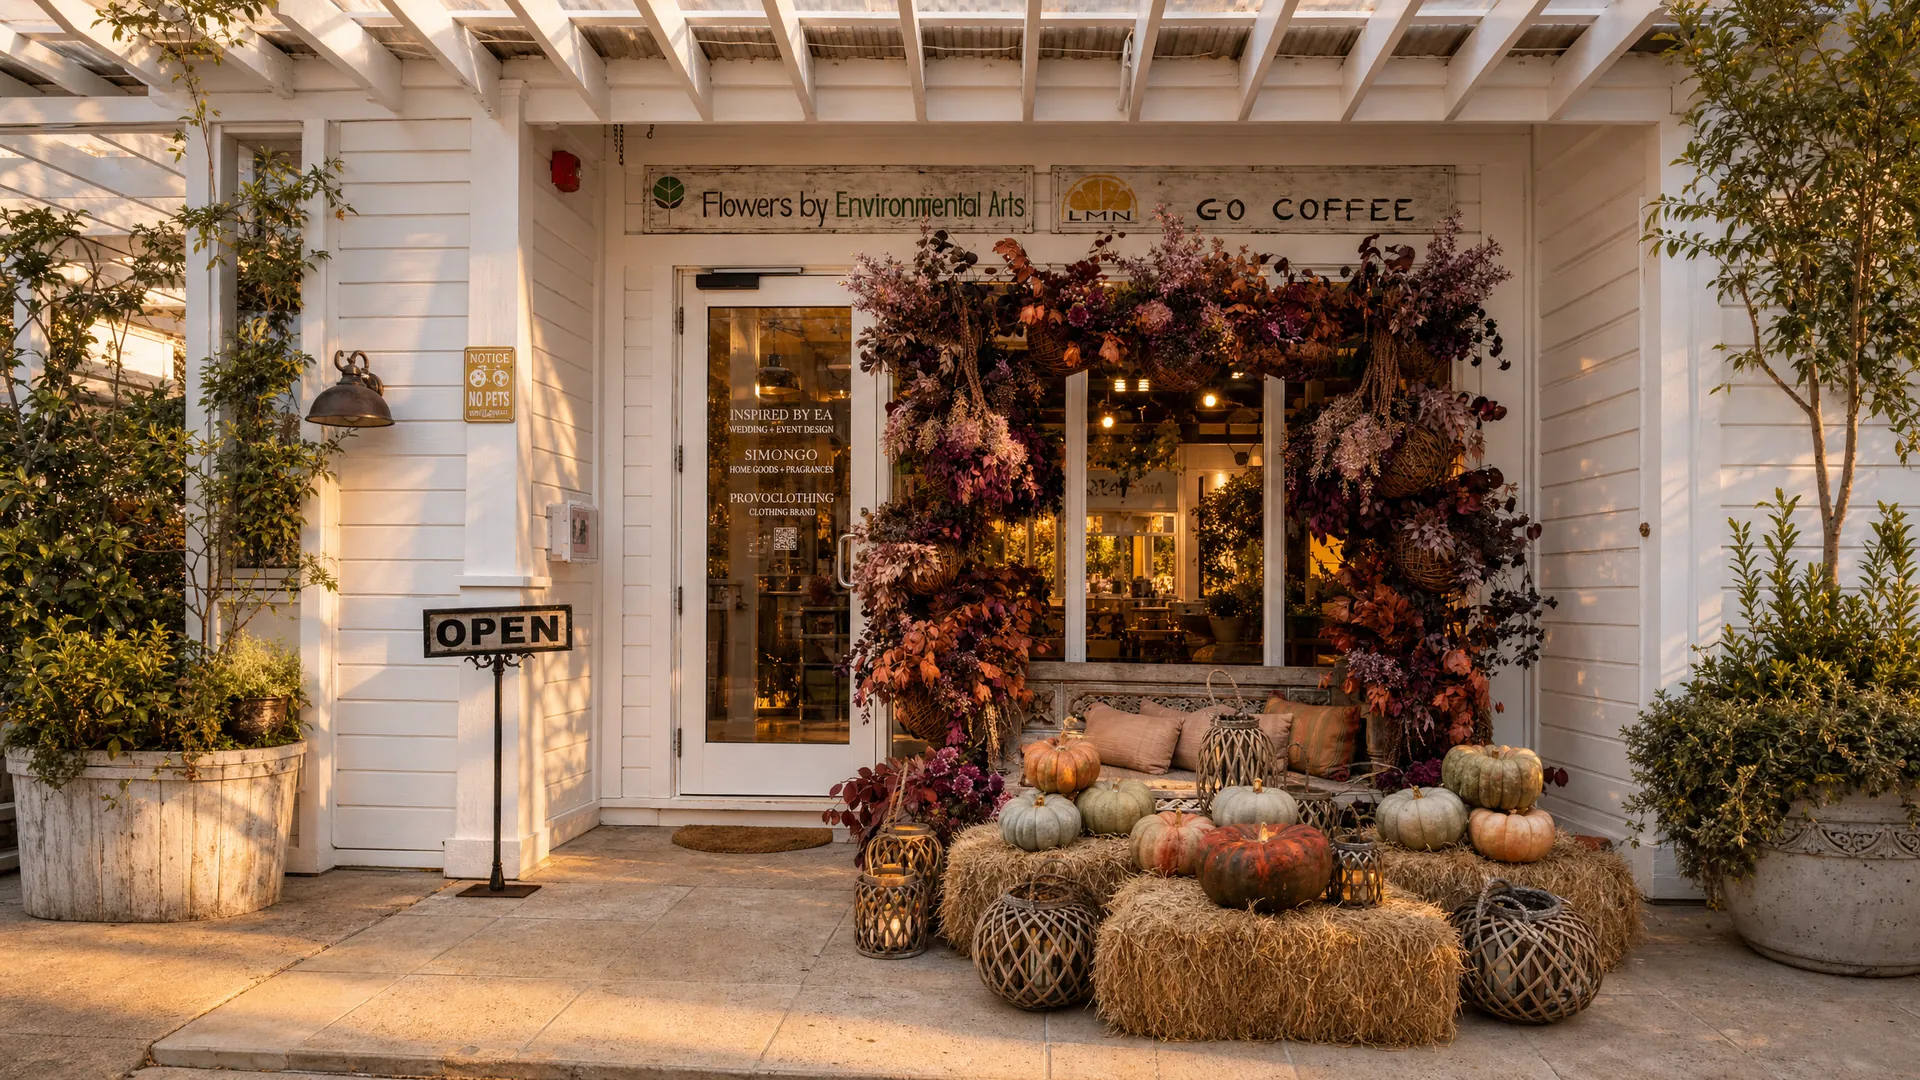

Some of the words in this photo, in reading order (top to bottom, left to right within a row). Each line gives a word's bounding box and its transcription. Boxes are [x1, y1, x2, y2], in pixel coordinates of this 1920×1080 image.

[701, 190, 793, 218] Flowers
[800, 190, 829, 228] by
[836, 190, 981, 218] Environmental
[988, 190, 1025, 218] Arts
[1196, 198, 1246, 222] GO
[1272, 198, 1415, 222] COFFEE
[1069, 210, 1131, 222] LMN
[470, 353, 510, 364] NOTICE
[468, 391, 483, 407] NO
[485, 391, 510, 407] PETS
[729, 409, 789, 421] INSPIRED
[793, 409, 810, 421] BY
[814, 409, 833, 421] EA
[729, 425, 768, 434] WEDDING
[776, 425, 803, 434] EVENT
[804, 425, 834, 434] DESIGN
[745, 449, 818, 461] SIMONGO
[729, 465, 751, 474] HOME
[752, 465, 779, 474] GOODS
[730, 492, 834, 504] PROVOCLOTHING
[749, 508, 789, 516] CLOTHING
[789, 508, 816, 516] BRAND
[436, 615, 559, 648] OPEN
